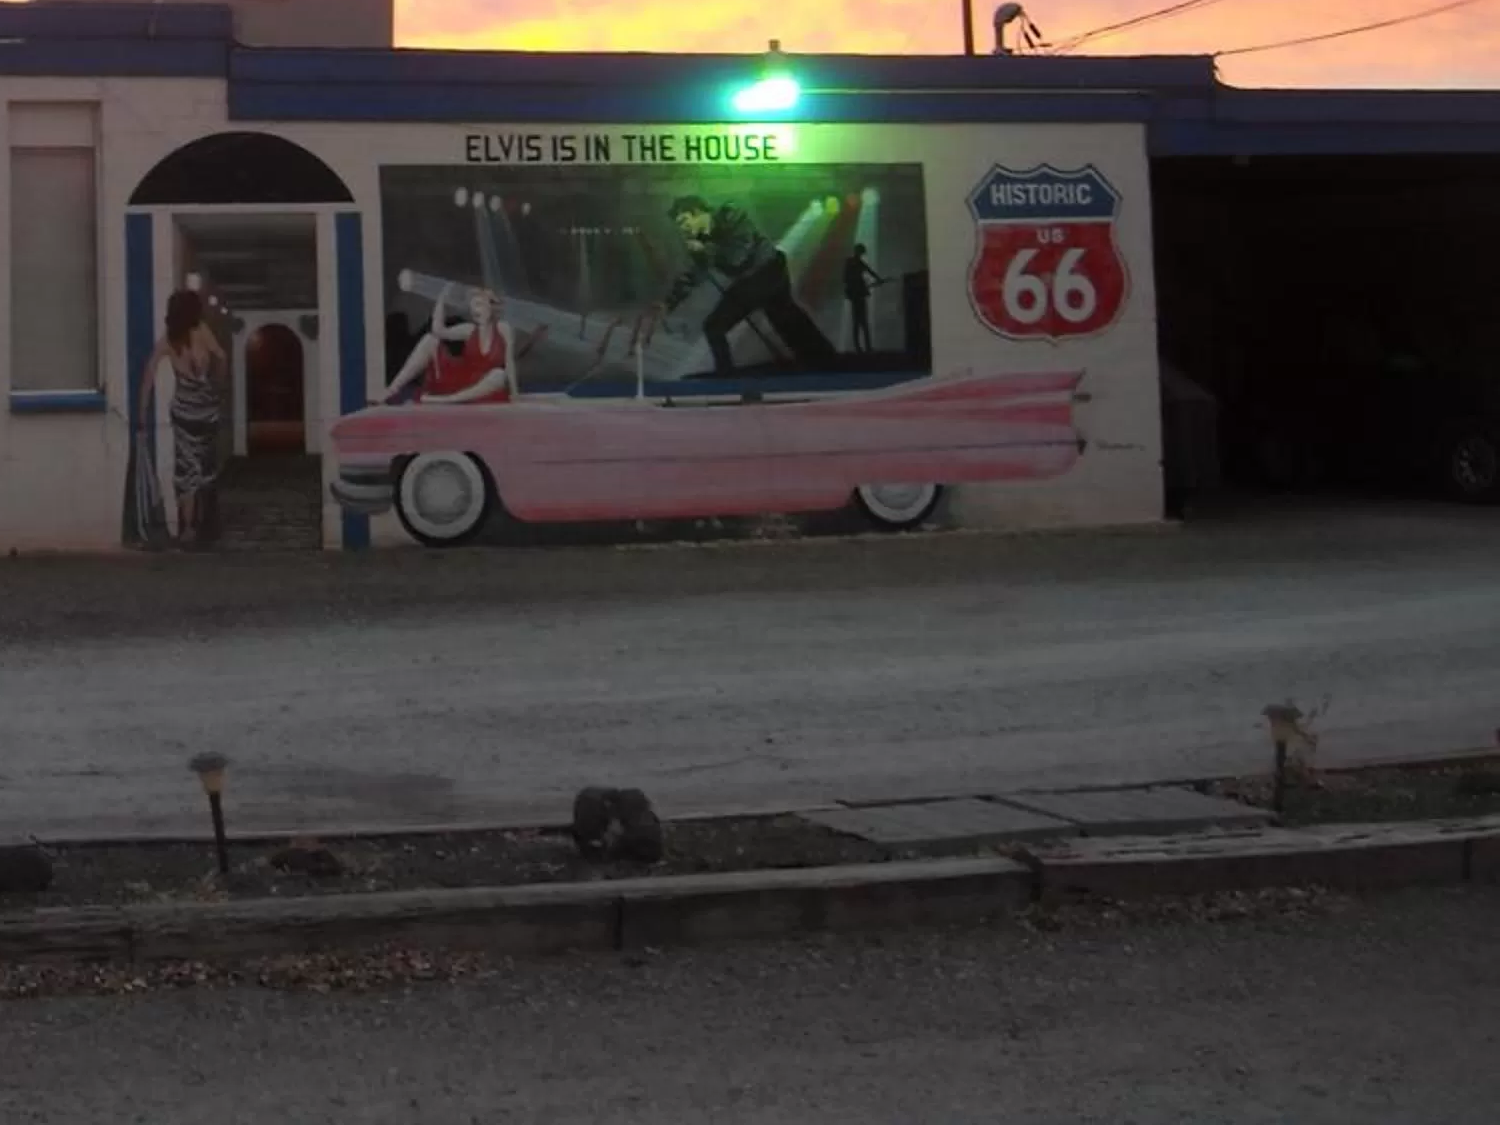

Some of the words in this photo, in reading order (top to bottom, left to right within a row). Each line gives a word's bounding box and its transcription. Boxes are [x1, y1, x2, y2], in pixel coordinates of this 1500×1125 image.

[465, 134, 542, 162] ELVIS
[551, 134, 577, 161] IS
[584, 135, 610, 161] IN
[621, 135, 675, 161] THE
[684, 135, 779, 161] HOUSE
[990, 183, 1092, 205] HISTORIC
[1036, 228, 1064, 244] US
[1003, 248, 1097, 323] 66
